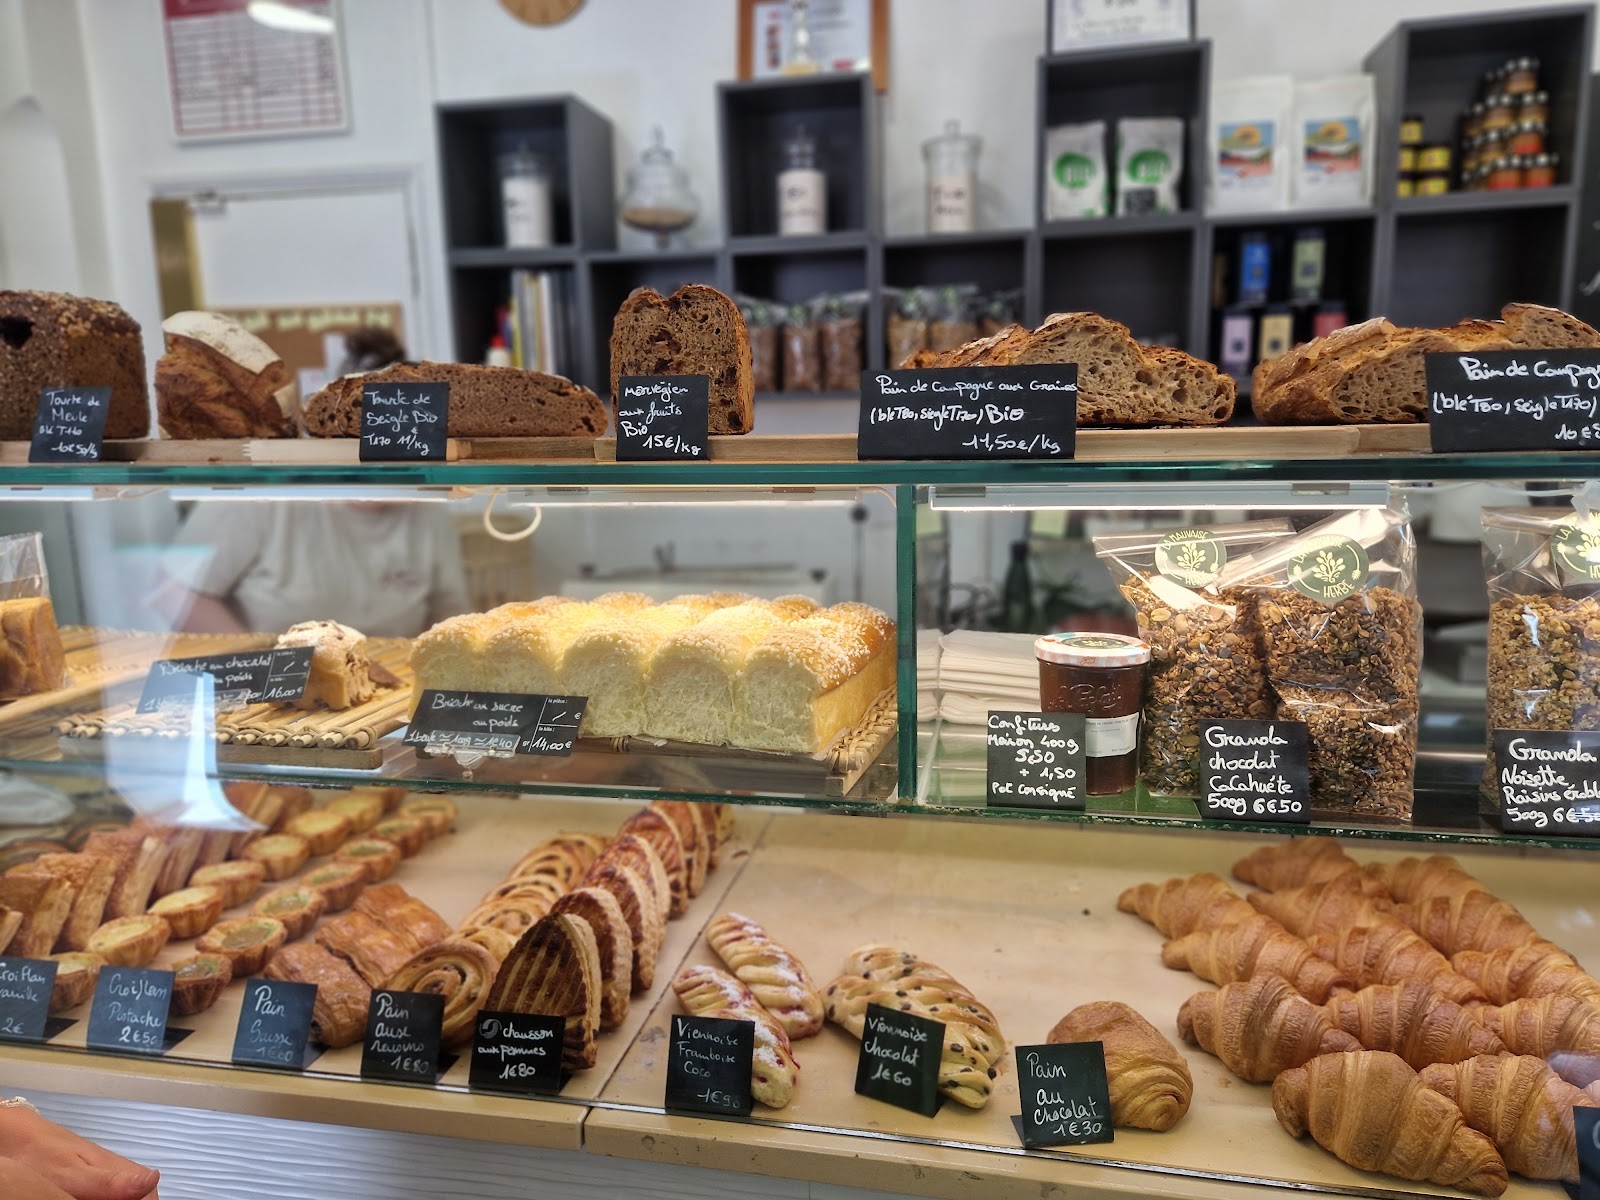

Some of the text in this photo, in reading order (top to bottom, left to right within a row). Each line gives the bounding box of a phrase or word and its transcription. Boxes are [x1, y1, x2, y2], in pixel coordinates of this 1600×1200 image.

[1459, 357, 1504, 381] Pain
[1506, 360, 1529, 376] de
[46, 389, 101, 406] Tourte de
[364, 388, 431, 405] Tourte de
[875, 375, 908, 395] Pain
[910, 379, 928, 393] de
[931, 381, 996, 401] Campagne
[998, 382, 1024, 392] aux
[52, 407, 88, 422] Meule
[366, 409, 438, 433] Seigle Bio
[618, 401, 683, 425] aux fruits
[985, 403, 1024, 424] Bio
[620, 420, 648, 437] Bio
[642, 434, 702, 456] 15€/kg
[1169, 530, 1209, 542] MAUVAISE
[1323, 579, 1354, 598] HERBE
[225, 654, 272, 668] chocolat
[225, 672, 253, 687] poids
[491, 701, 523, 712] sucre
[489, 715, 518, 732] poids
[987, 733, 1034, 749] Maison
[1205, 725, 1288, 747] Granola
[1209, 750, 1280, 770] chocolat
[1508, 738, 1598, 762] Granola
[1040, 767, 1076, 780] 1,50
[1501, 764, 1569, 786] Noisette
[1208, 793, 1302, 815] 500g 6€50
[1503, 786, 1561, 805] Raisins
[1506, 807, 1548, 827] 500g
[255, 985, 285, 1017] Pain
[376, 992, 409, 1019] Pain
[108, 1001, 161, 1027] Pistache
[1, 1017, 24, 1035] 2€
[250, 1019, 292, 1046] Suisse
[503, 1022, 553, 1039] chausson
[677, 1018, 739, 1046] Viennoise
[677, 1041, 736, 1063] Framboise
[864, 1036, 919, 1066] chocolat
[499, 1063, 535, 1079] 1€80
[684, 1061, 711, 1077] Coco
[871, 1063, 912, 1086] 1€60
[1026, 1052, 1067, 1078] Pain
[1036, 1088, 1064, 1105] au
[1053, 1120, 1102, 1136] 1€30
